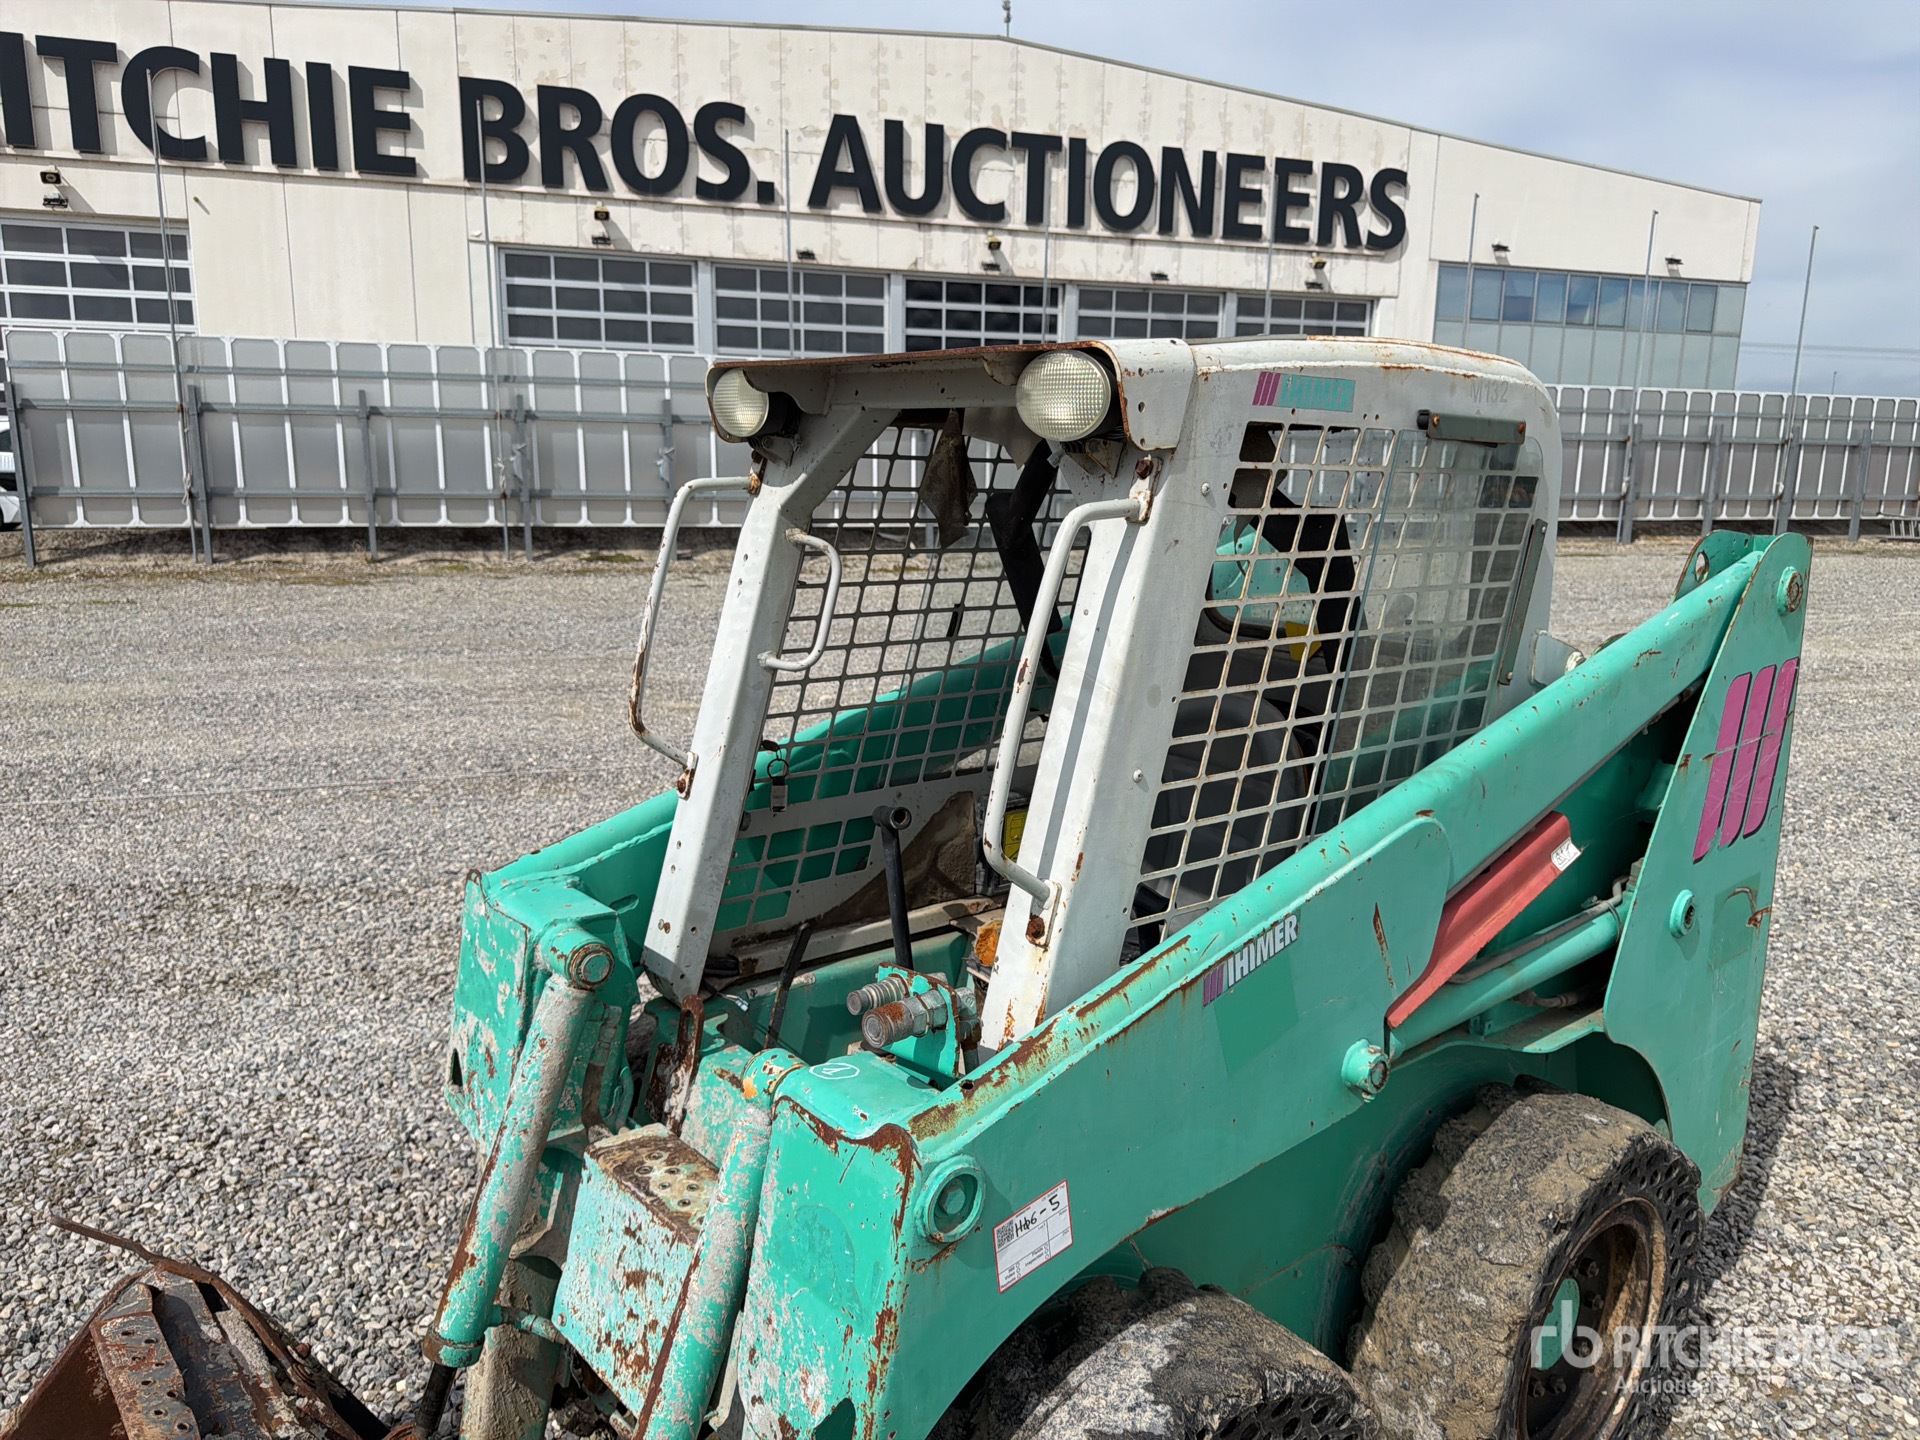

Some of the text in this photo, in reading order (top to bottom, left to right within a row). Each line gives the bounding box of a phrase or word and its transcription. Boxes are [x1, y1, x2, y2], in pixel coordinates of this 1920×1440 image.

[459, 76, 775, 205] BROS.
[807, 113, 1408, 251] AUCTIONEERS
[1227, 914, 1298, 988] IHIMER
